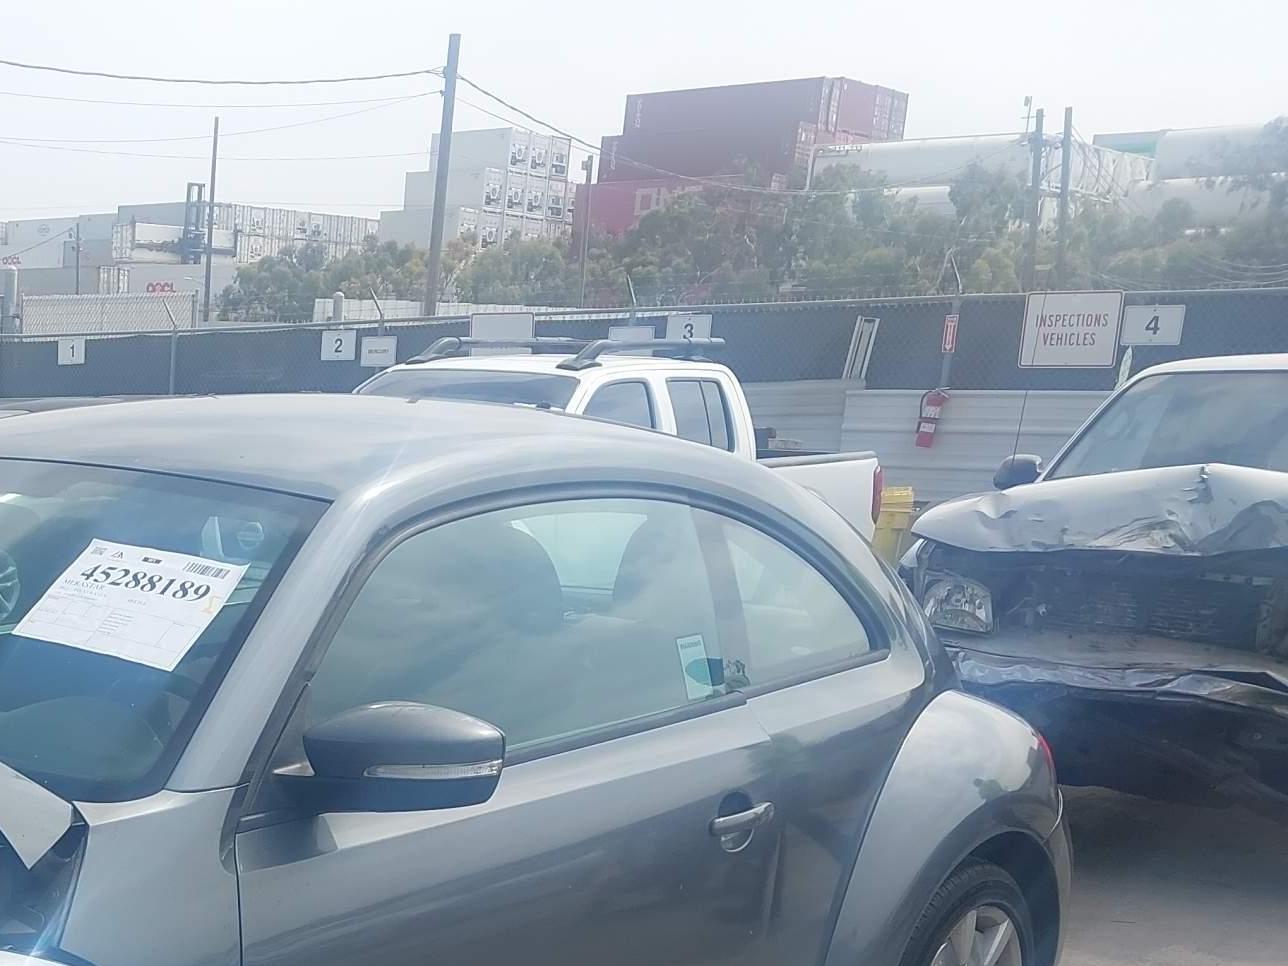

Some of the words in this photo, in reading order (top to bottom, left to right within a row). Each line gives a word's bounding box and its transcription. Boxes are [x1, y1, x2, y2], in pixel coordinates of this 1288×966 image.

[1035, 313, 1109, 328] INSPECTIONS
[1145, 315, 1160, 335] 4
[682, 323, 694, 339] 3
[334, 338, 343, 353] 2
[1042, 332, 1096, 346] VEHICLES
[70, 343, 75, 358] 1
[80, 564, 211, 602] 45288189
